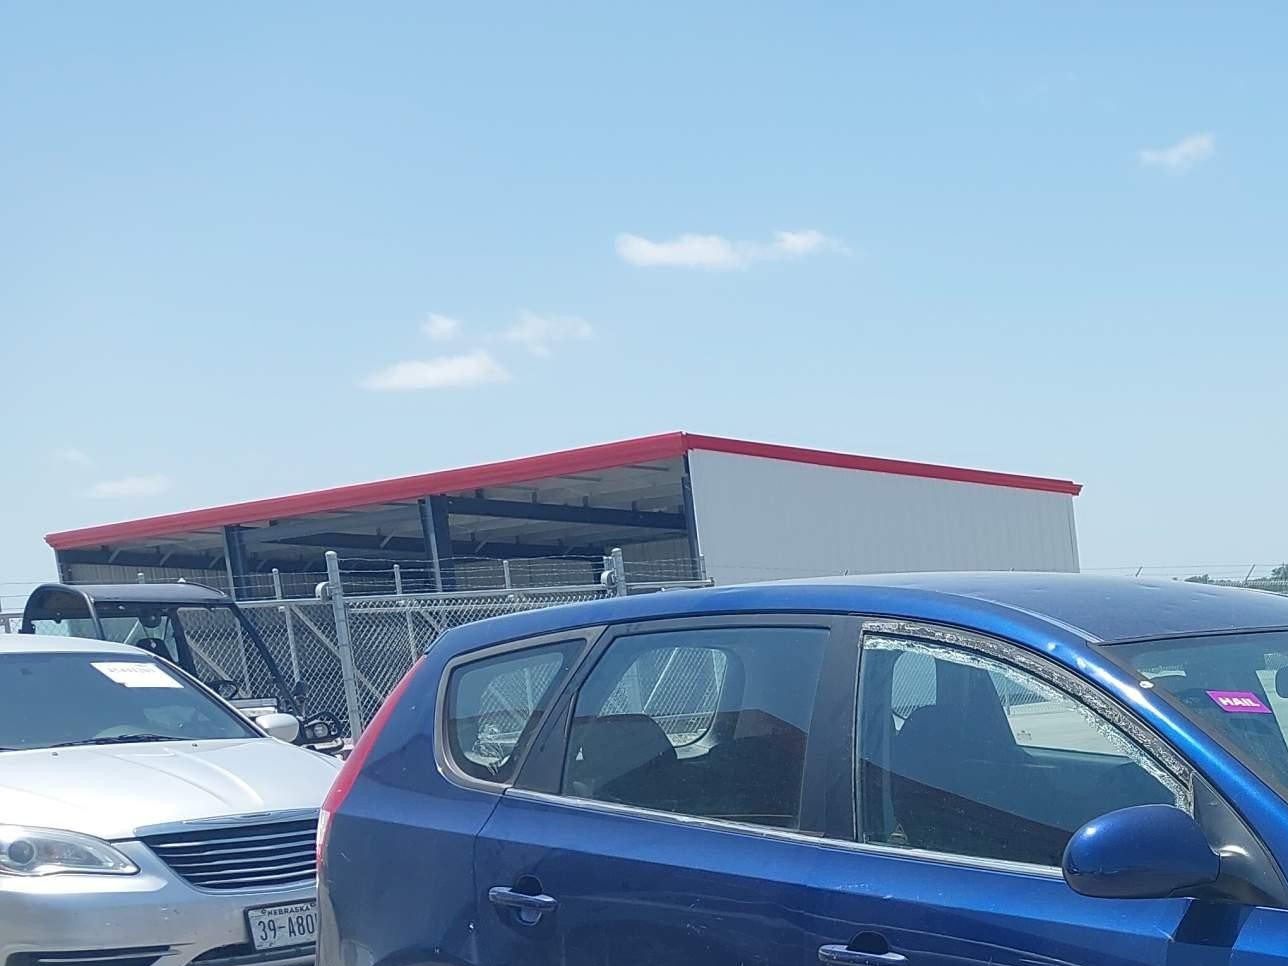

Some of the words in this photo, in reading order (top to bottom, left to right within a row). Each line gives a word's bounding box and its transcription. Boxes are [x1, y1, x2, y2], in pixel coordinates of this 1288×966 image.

[1217, 697, 1261, 707] HAIL
[267, 904, 311, 917] NEBRASKA
[257, 912, 318, 941] 39-A80
